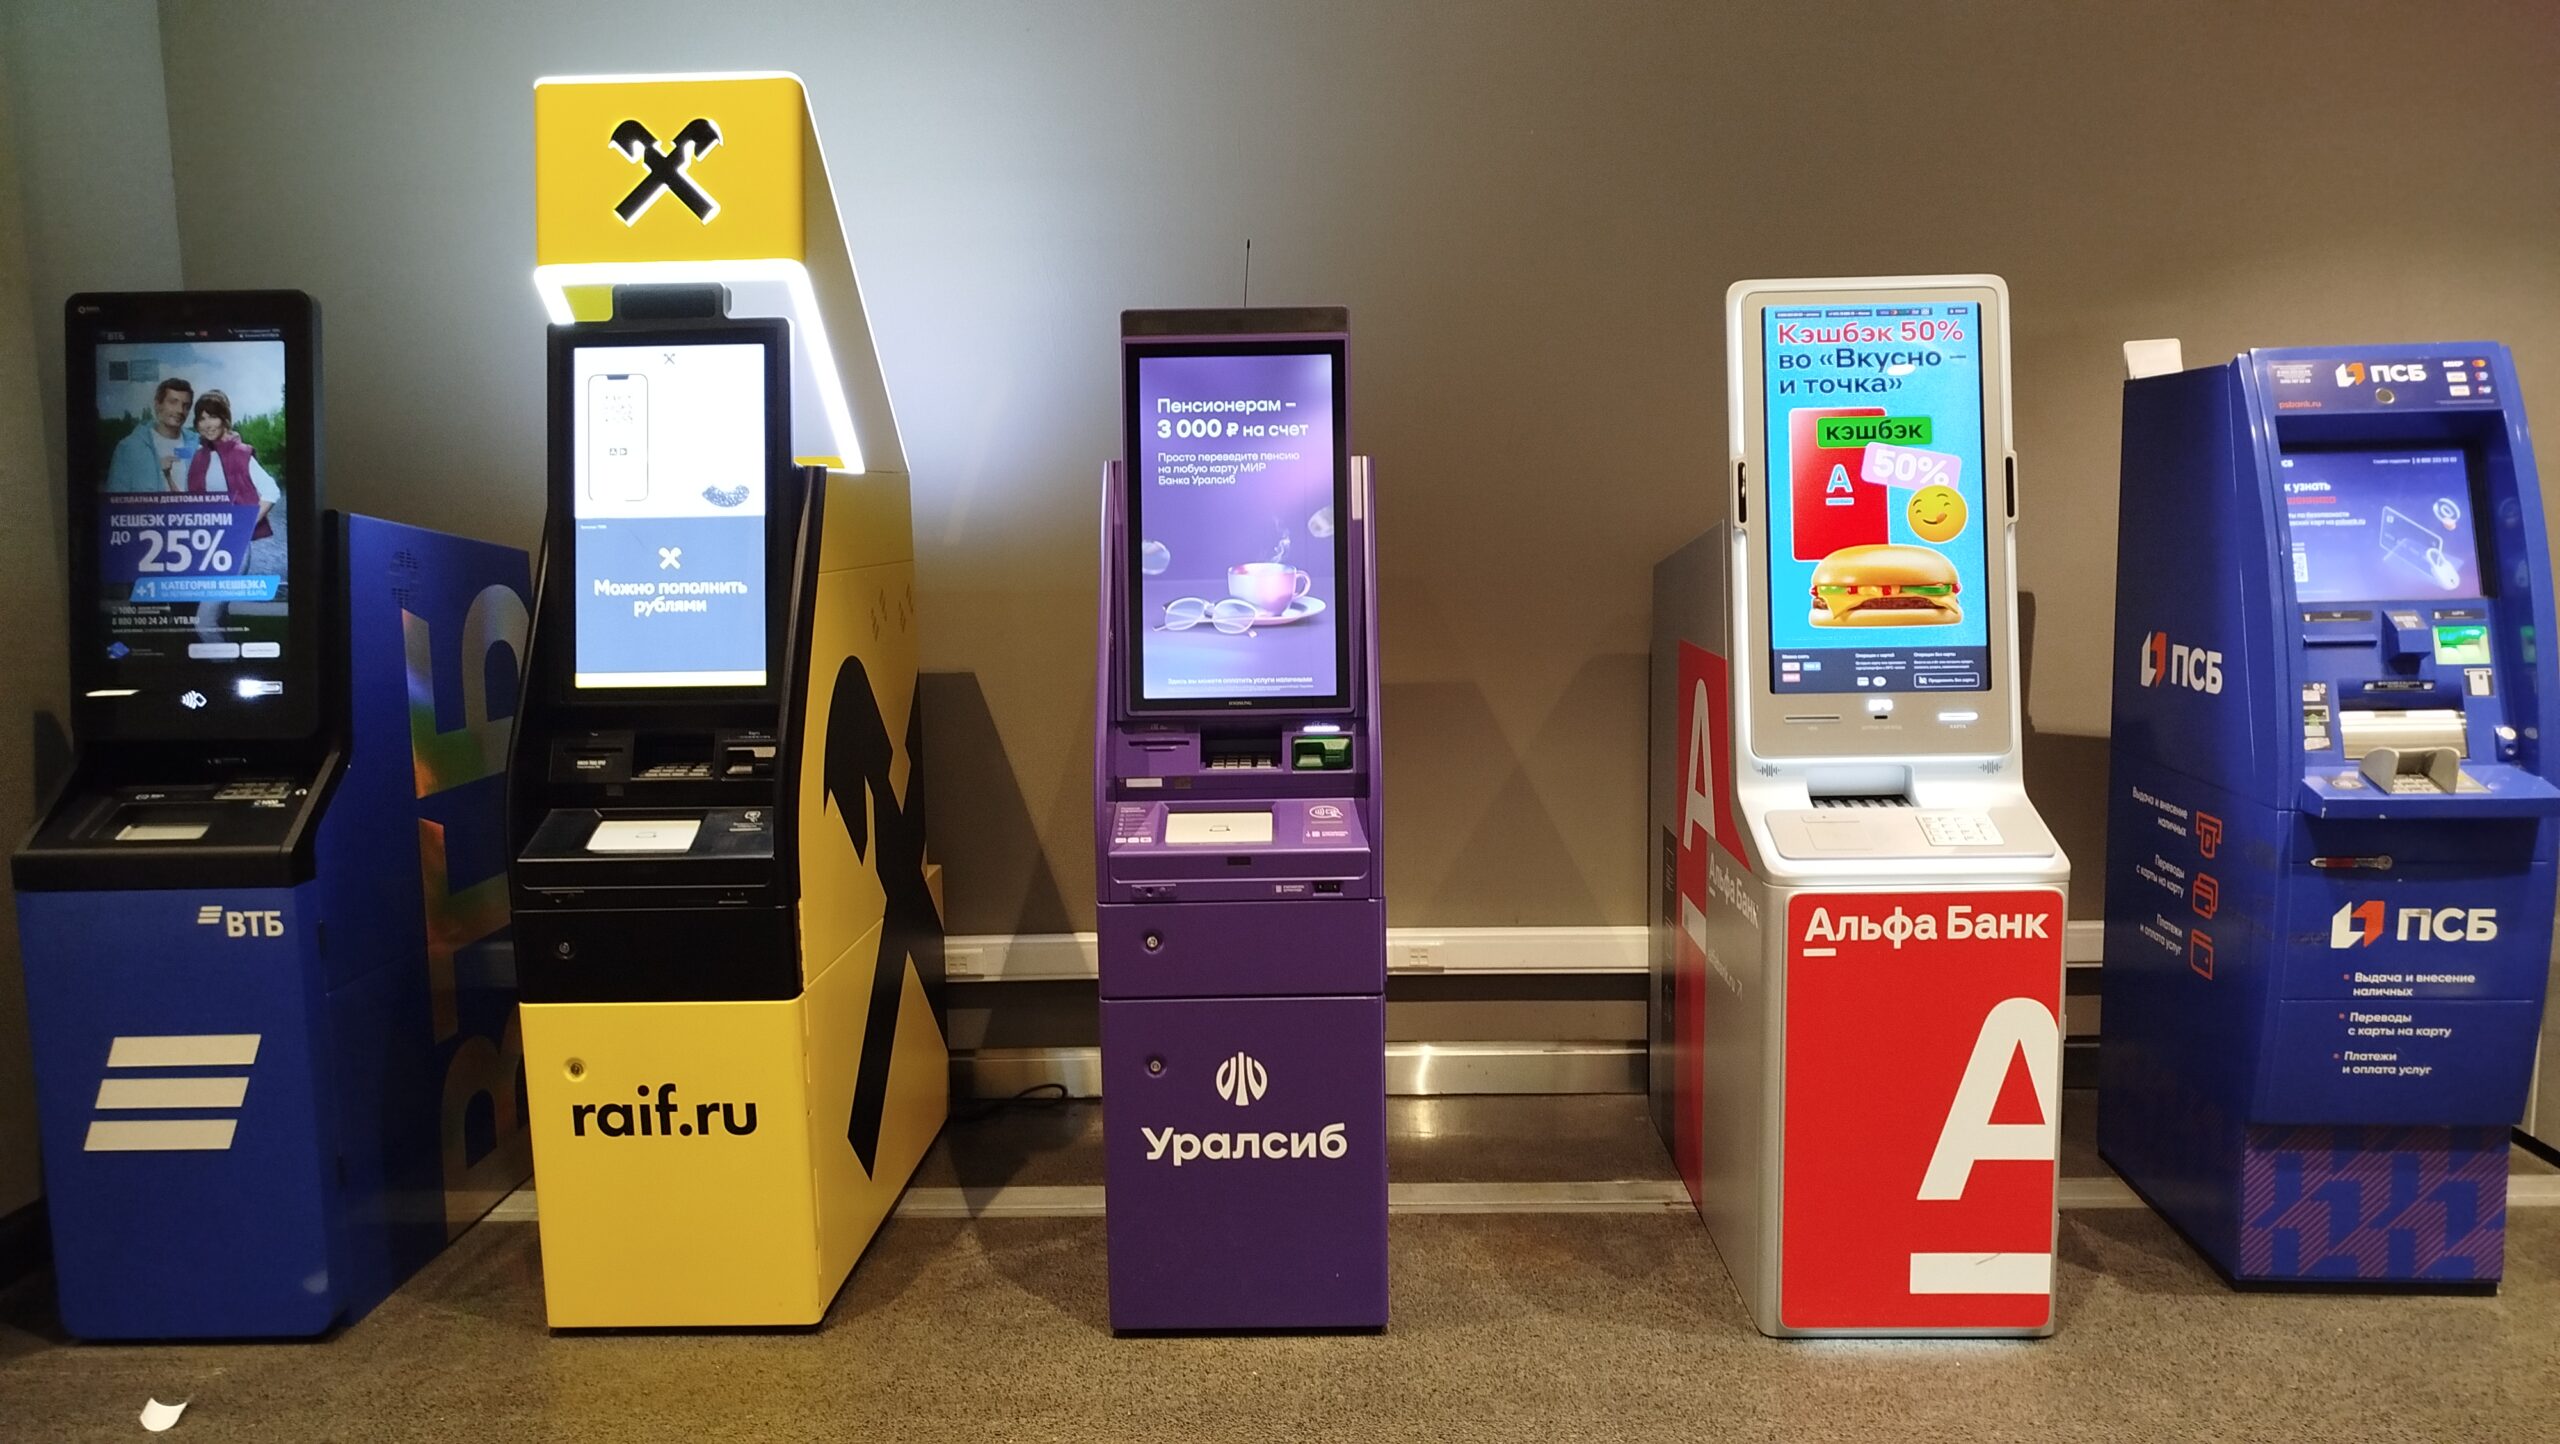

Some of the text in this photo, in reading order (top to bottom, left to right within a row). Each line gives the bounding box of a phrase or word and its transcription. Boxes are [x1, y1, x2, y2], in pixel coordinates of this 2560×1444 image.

[1778, 320, 1964, 344] Кэшбэк 50%
[1779, 353, 1812, 369] во
[1819, 348, 1942, 373] «Вкусно
[2370, 364, 2428, 383] ПСБ
[1779, 377, 1903, 394] и точка»
[1157, 398, 1281, 415] Пенсионерам
[1157, 419, 1172, 438] 3
[1176, 418, 1223, 438] 000
[1242, 424, 1265, 437] на
[1268, 424, 1309, 436] счет
[1825, 419, 1923, 441] кэшбэк
[1158, 452, 1300, 464] Просто переведите пенсию
[1158, 462, 1266, 476] на любую карту МИР
[1872, 450, 1949, 486] 50%
[1158, 474, 1236, 487] Банка Уралсиб
[2292, 482, 2331, 493] узнать
[110, 494, 231, 504] БЕСПЛАТНАЯ ДЕБЕТОВАЯ КАРТА
[111, 513, 232, 527] КЕШБЭК РУБЛЯМИ
[110, 531, 131, 546] ДО
[138, 529, 232, 573] 25%
[136, 581, 156, 598] +1
[161, 579, 267, 590] КАТЕГОРИЯ КЕШБЭКА
[593, 579, 748, 596] Можно пополнить
[633, 595, 707, 617] рублями
[148, 617, 157, 625] 24
[158, 616, 168, 624] 24
[2171, 643, 2223, 695] ПСБ
[2132, 786, 2188, 820] Выдача и внесение
[2157, 816, 2187, 837] наличных
[2155, 853, 2185, 879] Переводы
[1709, 852, 1760, 929] Альфа Банк
[2135, 864, 2185, 899] с карты на карту
[226, 910, 285, 938] ВТБ
[1804, 905, 2048, 949] Альфа Банк
[2156, 912, 2183, 938] Платежи
[2396, 908, 2498, 942] ПСБ
[2144, 926, 2165, 946] оплата
[2165, 938, 2183, 956] услуг
[2354, 972, 2476, 984] Выдача и внесение
[2352, 986, 2413, 997] наличных
[2350, 1012, 2412, 1024] Переводы
[2347, 1026, 2451, 1038] с карты на карту
[2344, 1051, 2397, 1061] Платежи
[2342, 1065, 2432, 1077] и оплата услуг
[573, 1083, 758, 1137] raif.ru
[1141, 1122, 1348, 1166] Уралсиб
